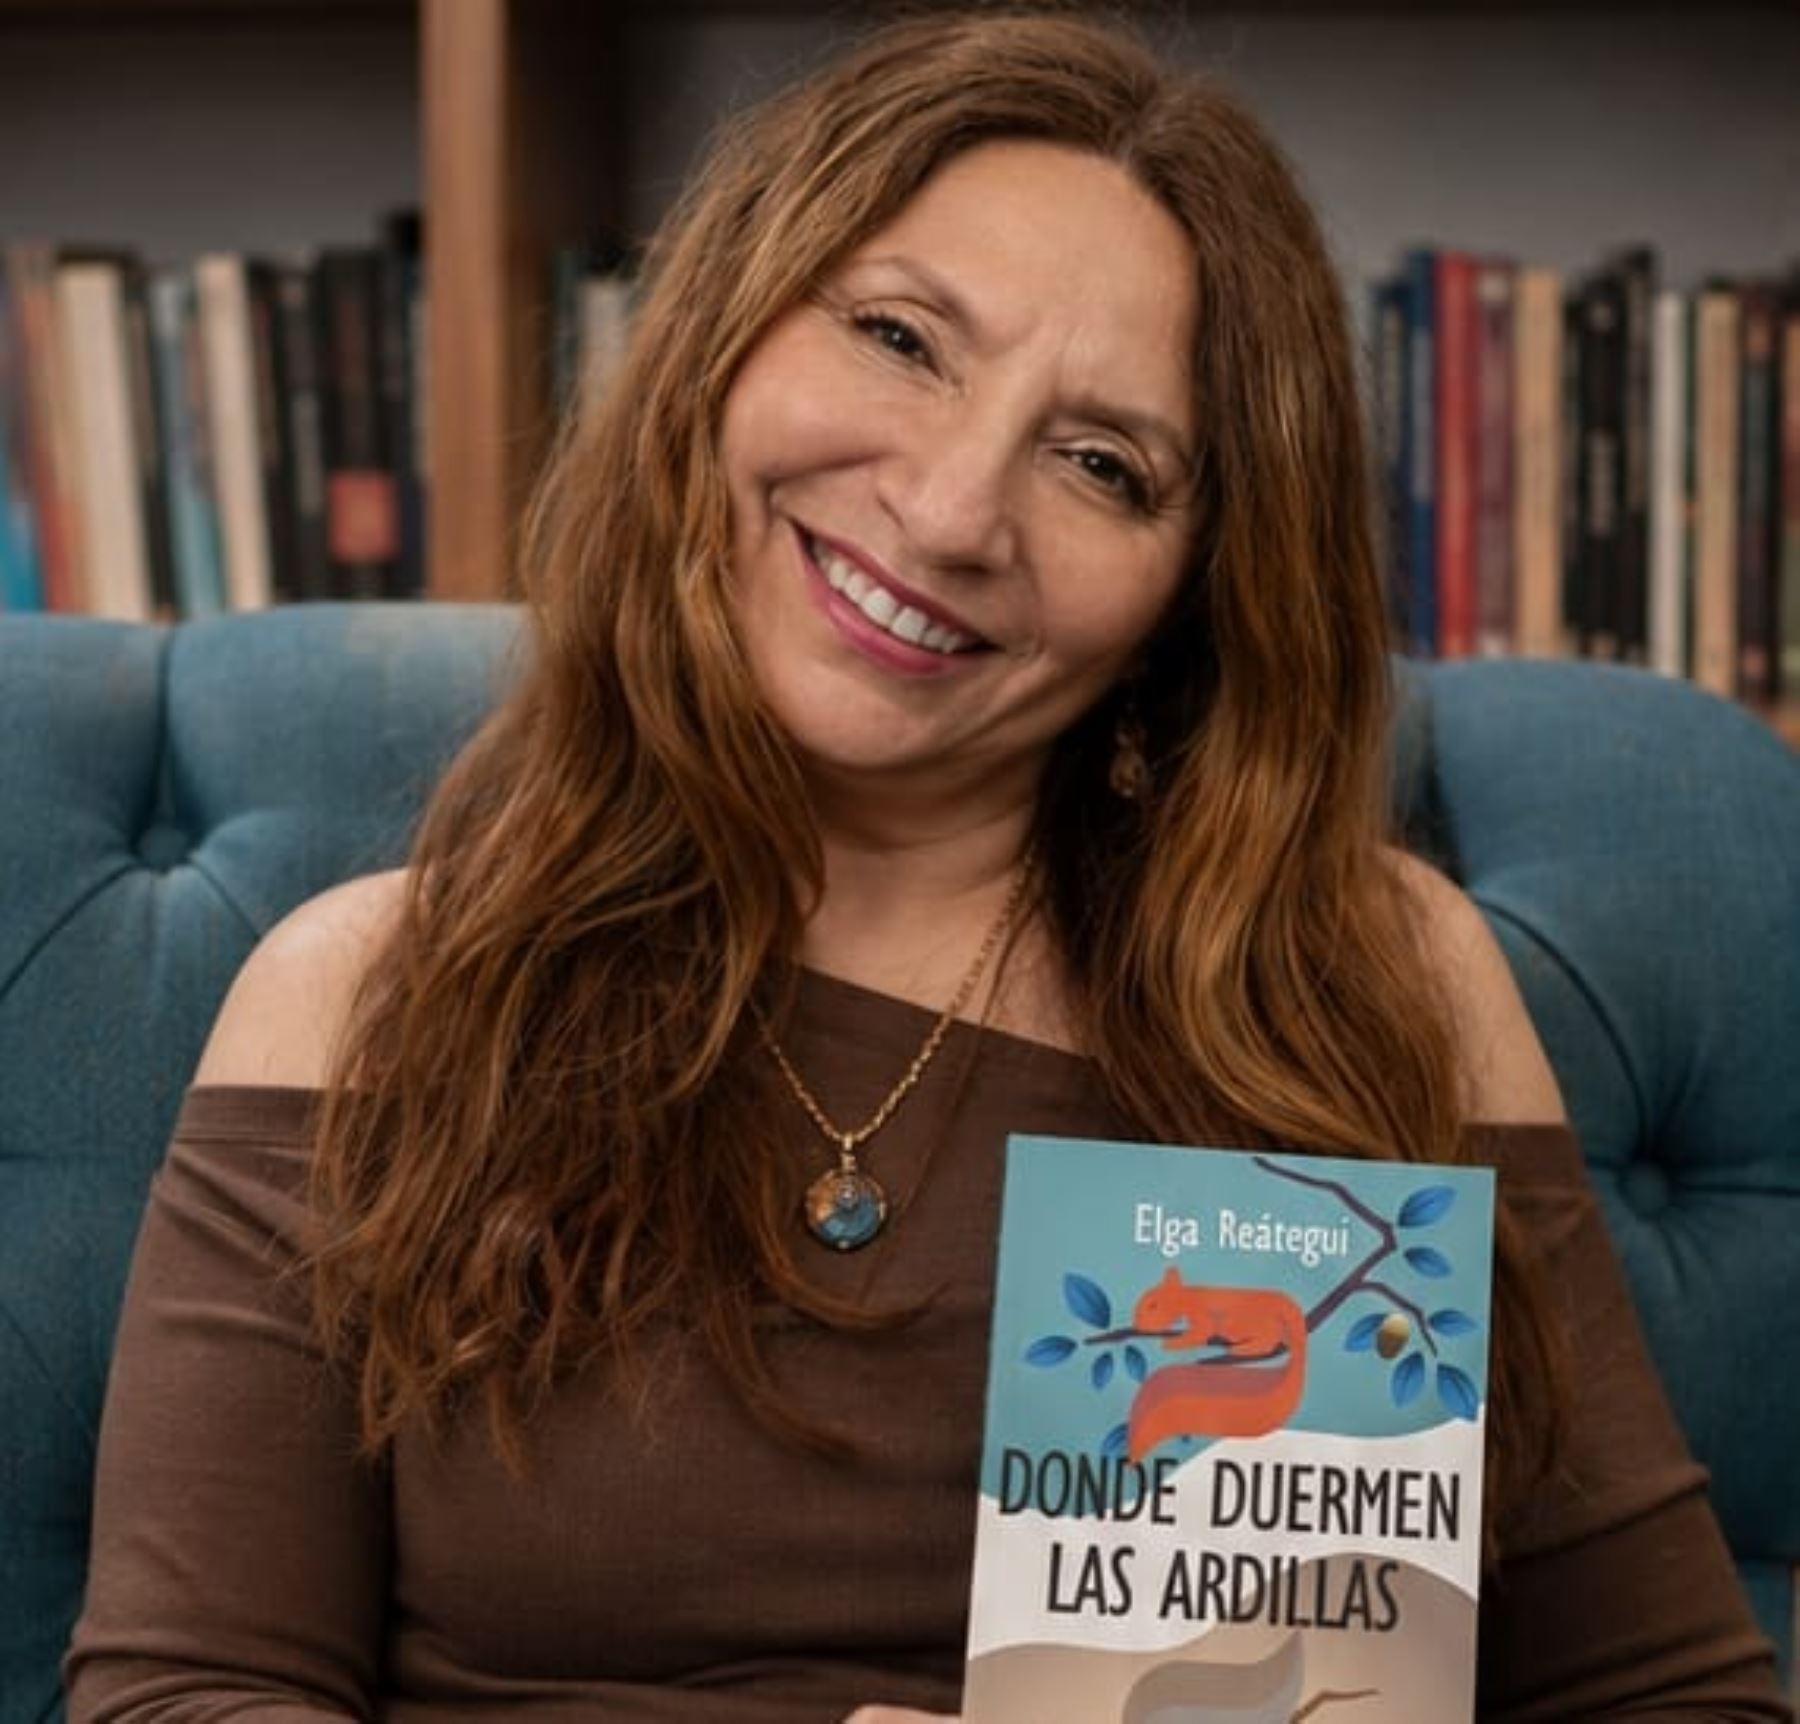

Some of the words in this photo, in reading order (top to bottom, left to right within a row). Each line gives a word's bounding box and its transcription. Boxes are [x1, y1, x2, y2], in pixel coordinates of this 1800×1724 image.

[1134, 1203, 1199, 1257] Elga
[1219, 1209, 1350, 1267] Reátegui
[998, 1448, 1178, 1526] DONDE
[1210, 1459, 1461, 1542] DUERMEN
[1047, 1541, 1136, 1617] LAS
[1158, 1548, 1400, 1632] ARDILLAS
